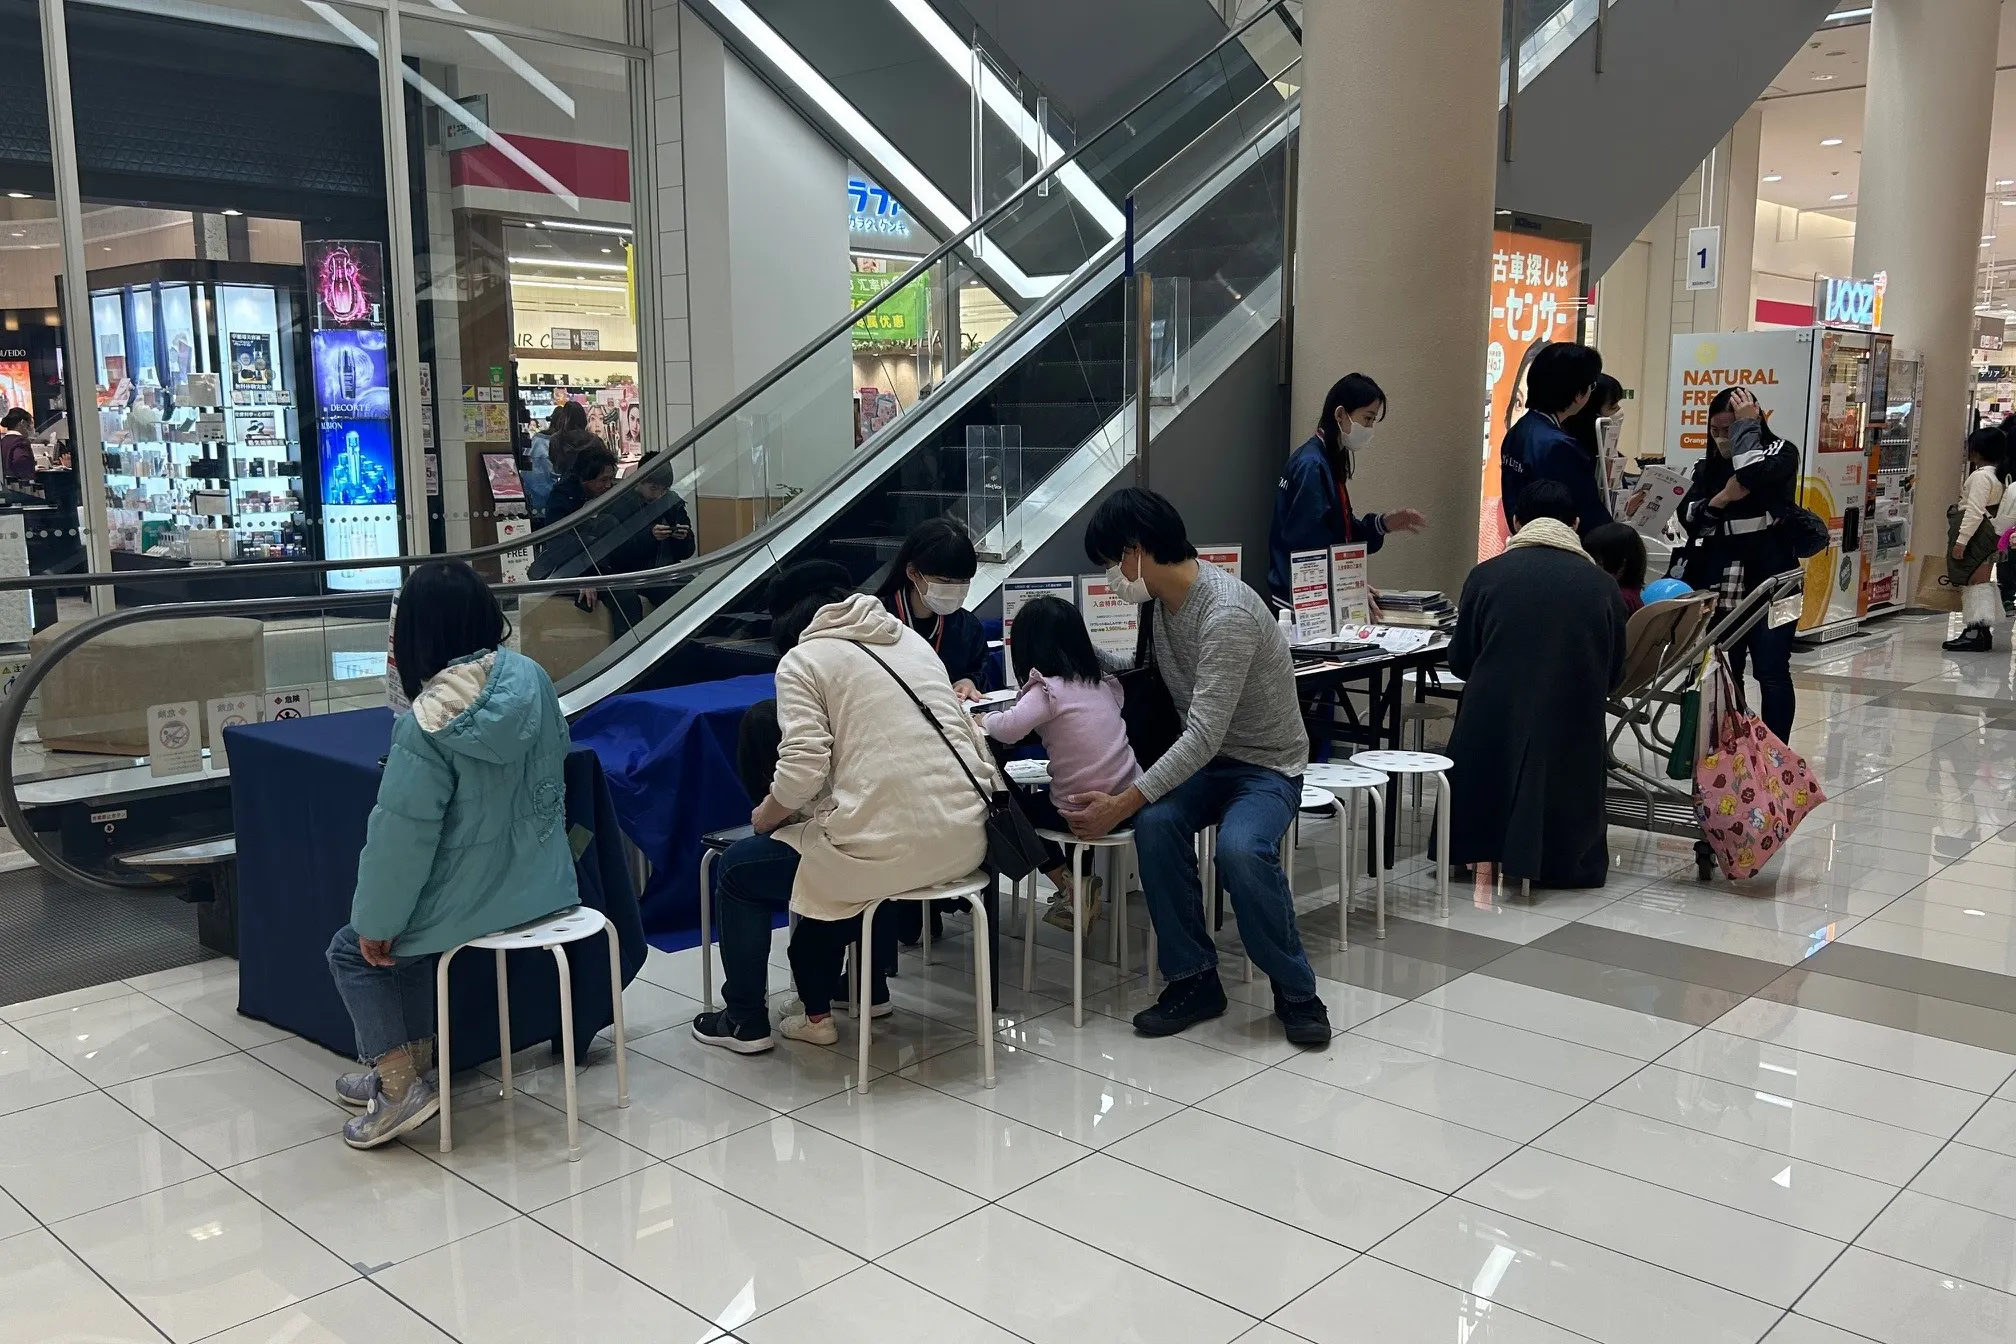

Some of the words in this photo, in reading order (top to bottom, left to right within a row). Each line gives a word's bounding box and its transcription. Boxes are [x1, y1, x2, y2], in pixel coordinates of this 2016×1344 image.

[1697, 248, 1706, 269] 1
[1493, 248, 1568, 287] 古車探しは
[1489, 287, 1567, 343] ーセンサー
[1683, 368, 1779, 386] NATURAL
[1682, 390, 1719, 406] FRE
[507, 548, 528, 558] FREE
[1092, 600, 1137, 608] 入会特典の
[285, 695, 301, 704] 危険
